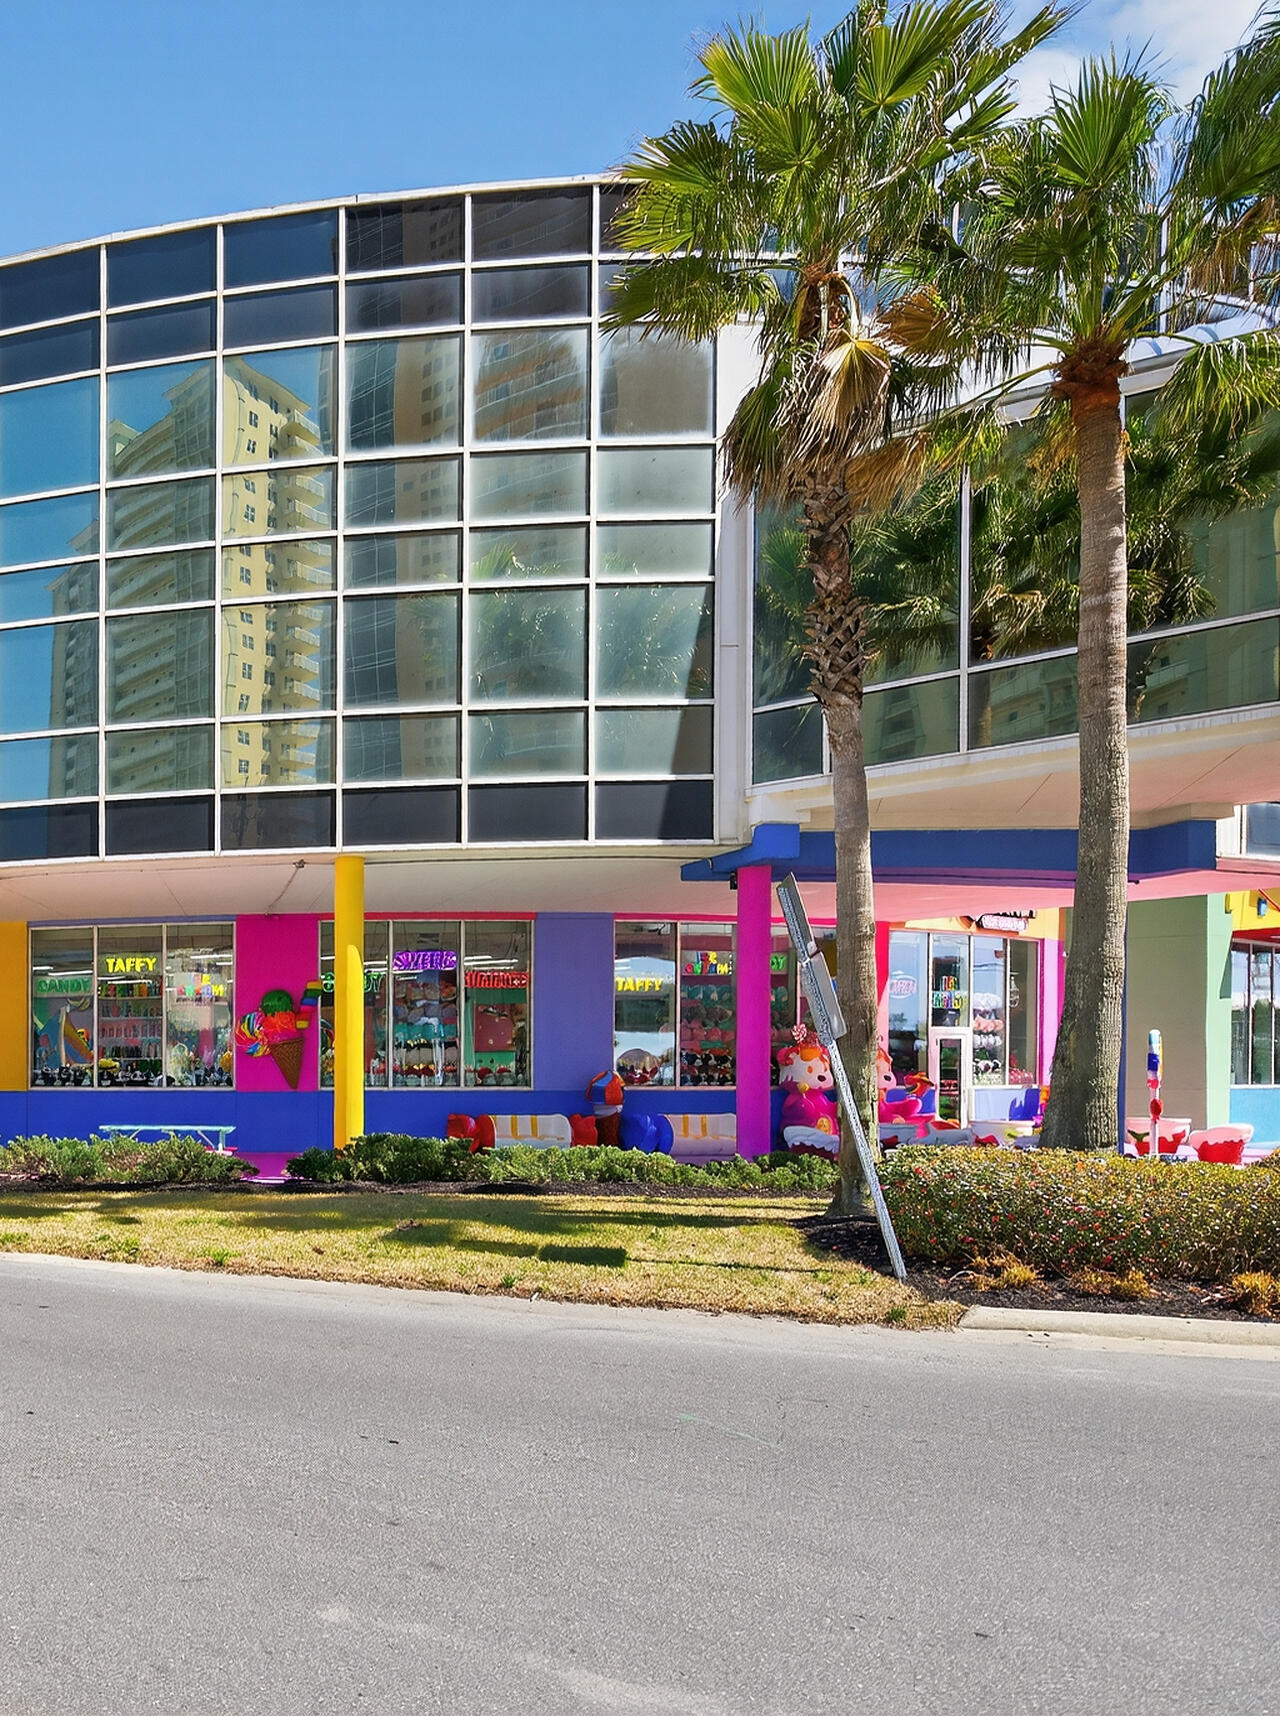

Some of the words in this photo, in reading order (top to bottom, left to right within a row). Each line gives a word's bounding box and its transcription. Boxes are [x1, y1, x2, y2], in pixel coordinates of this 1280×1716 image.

[106, 956, 157, 973] TAFFY
[37, 978, 92, 993] CANDY
[615, 977, 663, 992] TAFFY
